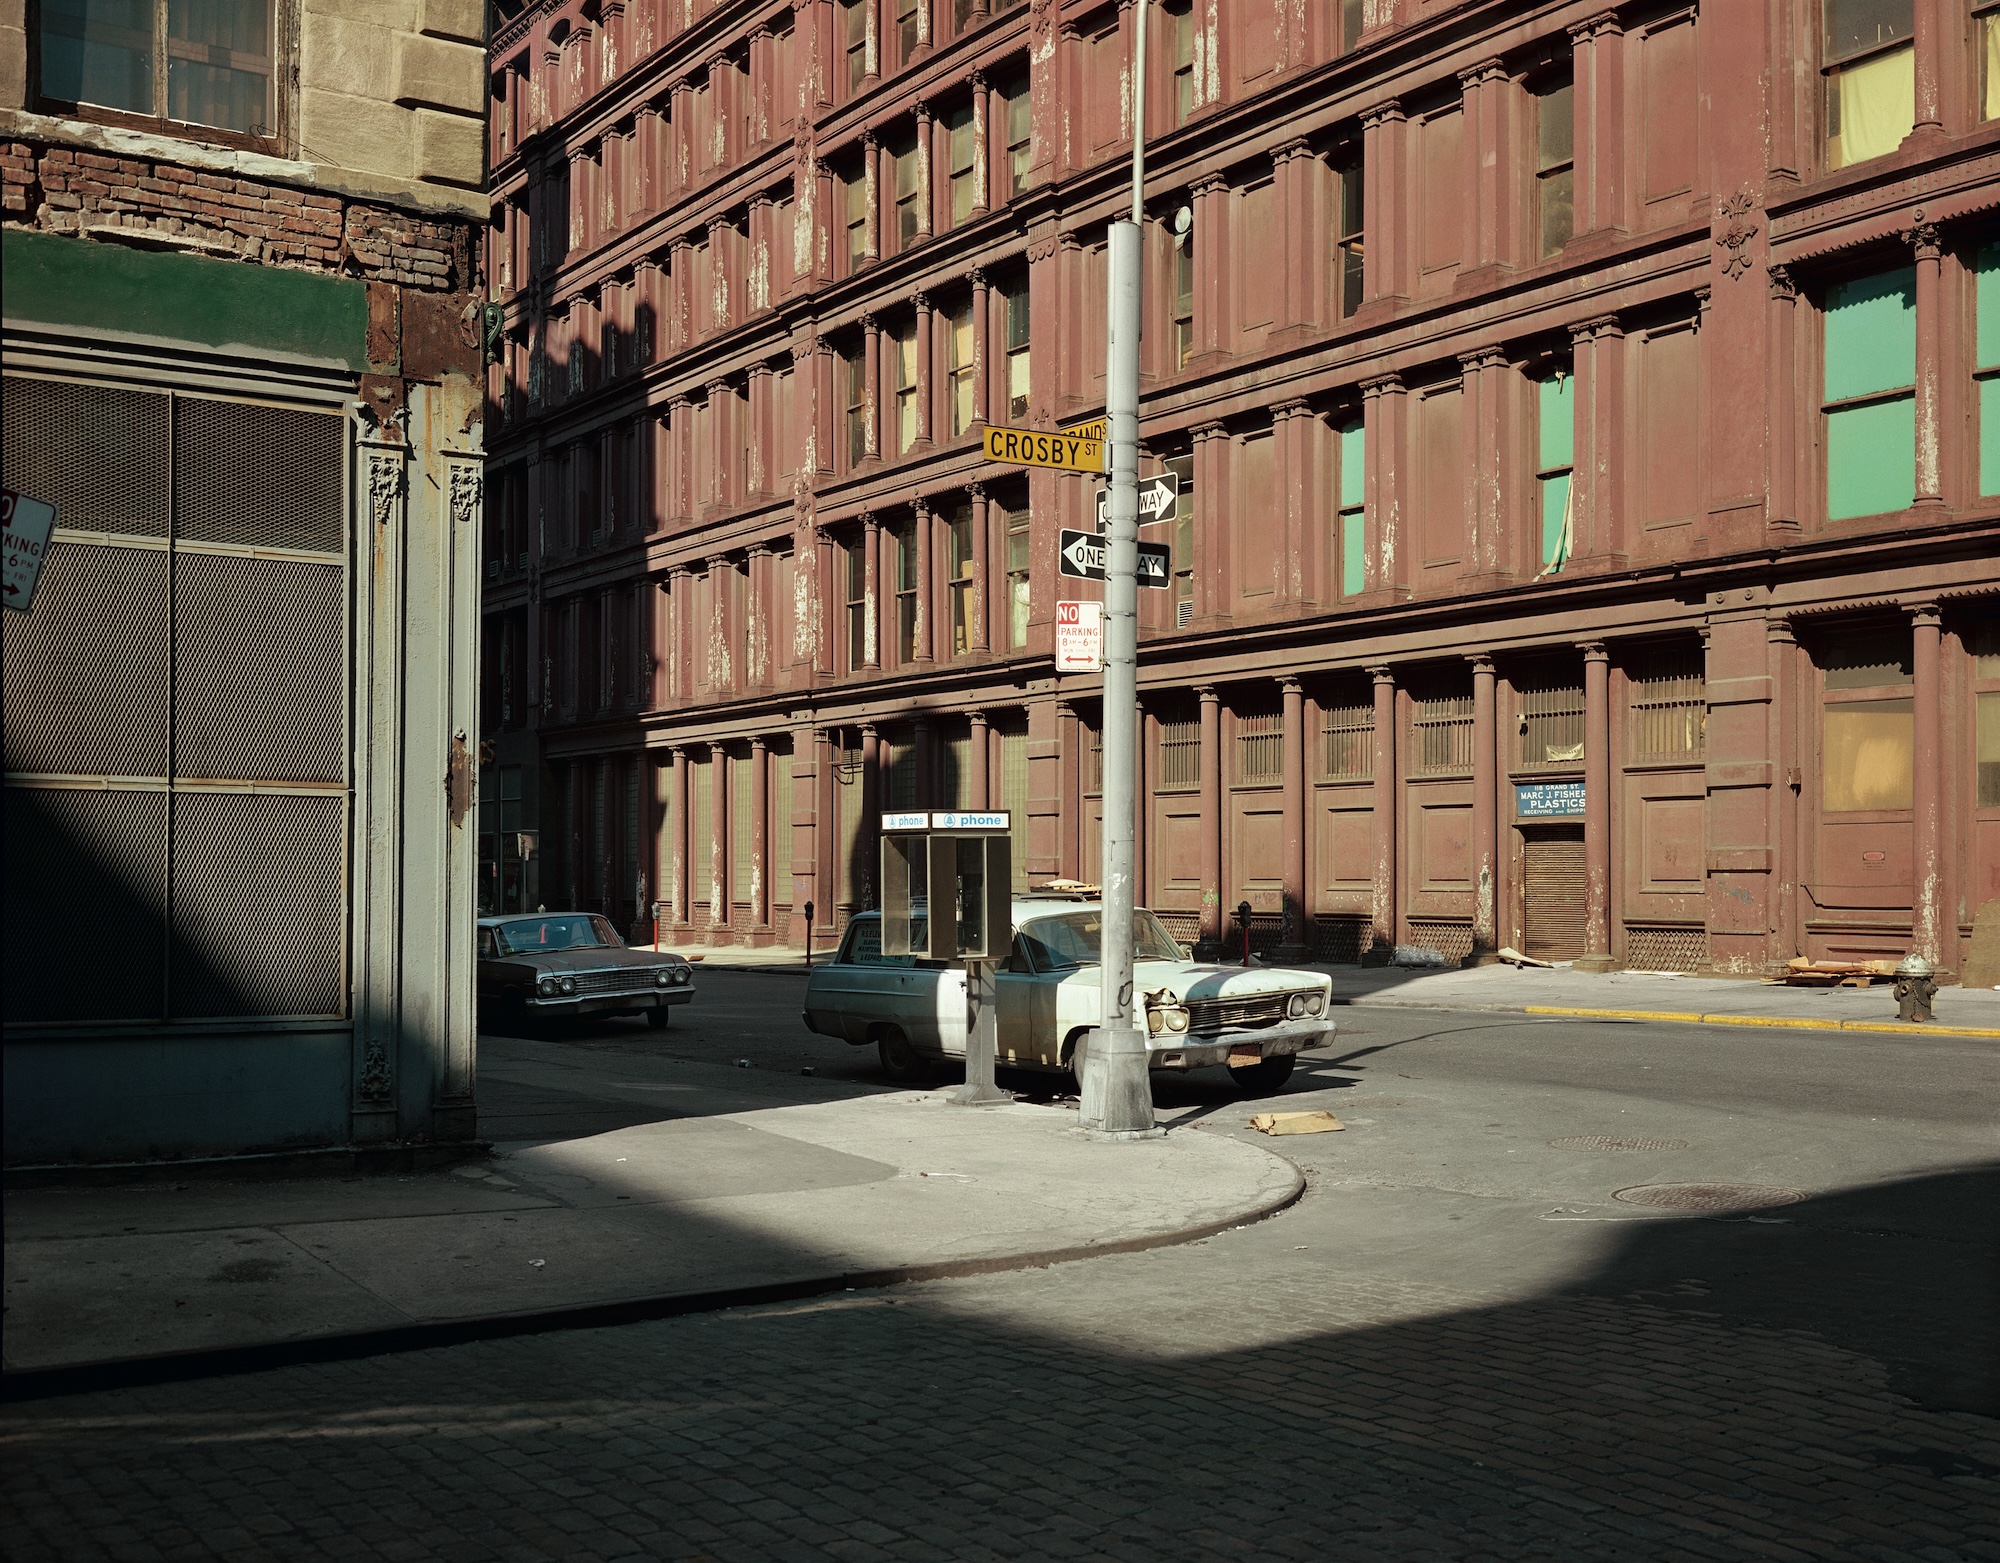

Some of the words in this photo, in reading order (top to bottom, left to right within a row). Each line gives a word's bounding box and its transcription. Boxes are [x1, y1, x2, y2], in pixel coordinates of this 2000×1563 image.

[991, 431, 1080, 466] CROSBY
[1085, 443, 1098, 457] ST
[2, 495, 14, 520] O
[1139, 490, 1164, 511] WAY
[3, 533, 40, 556] KING
[1075, 546, 1105, 567] ONE
[1137, 556, 1160, 573] AY
[1058, 606, 1079, 622] NO
[1061, 627, 1098, 637] PARKING
[1520, 791, 1544, 800] MARC
[1546, 790, 1553, 799] J.
[1530, 798, 1585, 809] PLASTICS
[898, 815, 924, 828] phone
[960, 814, 1002, 827] phone
